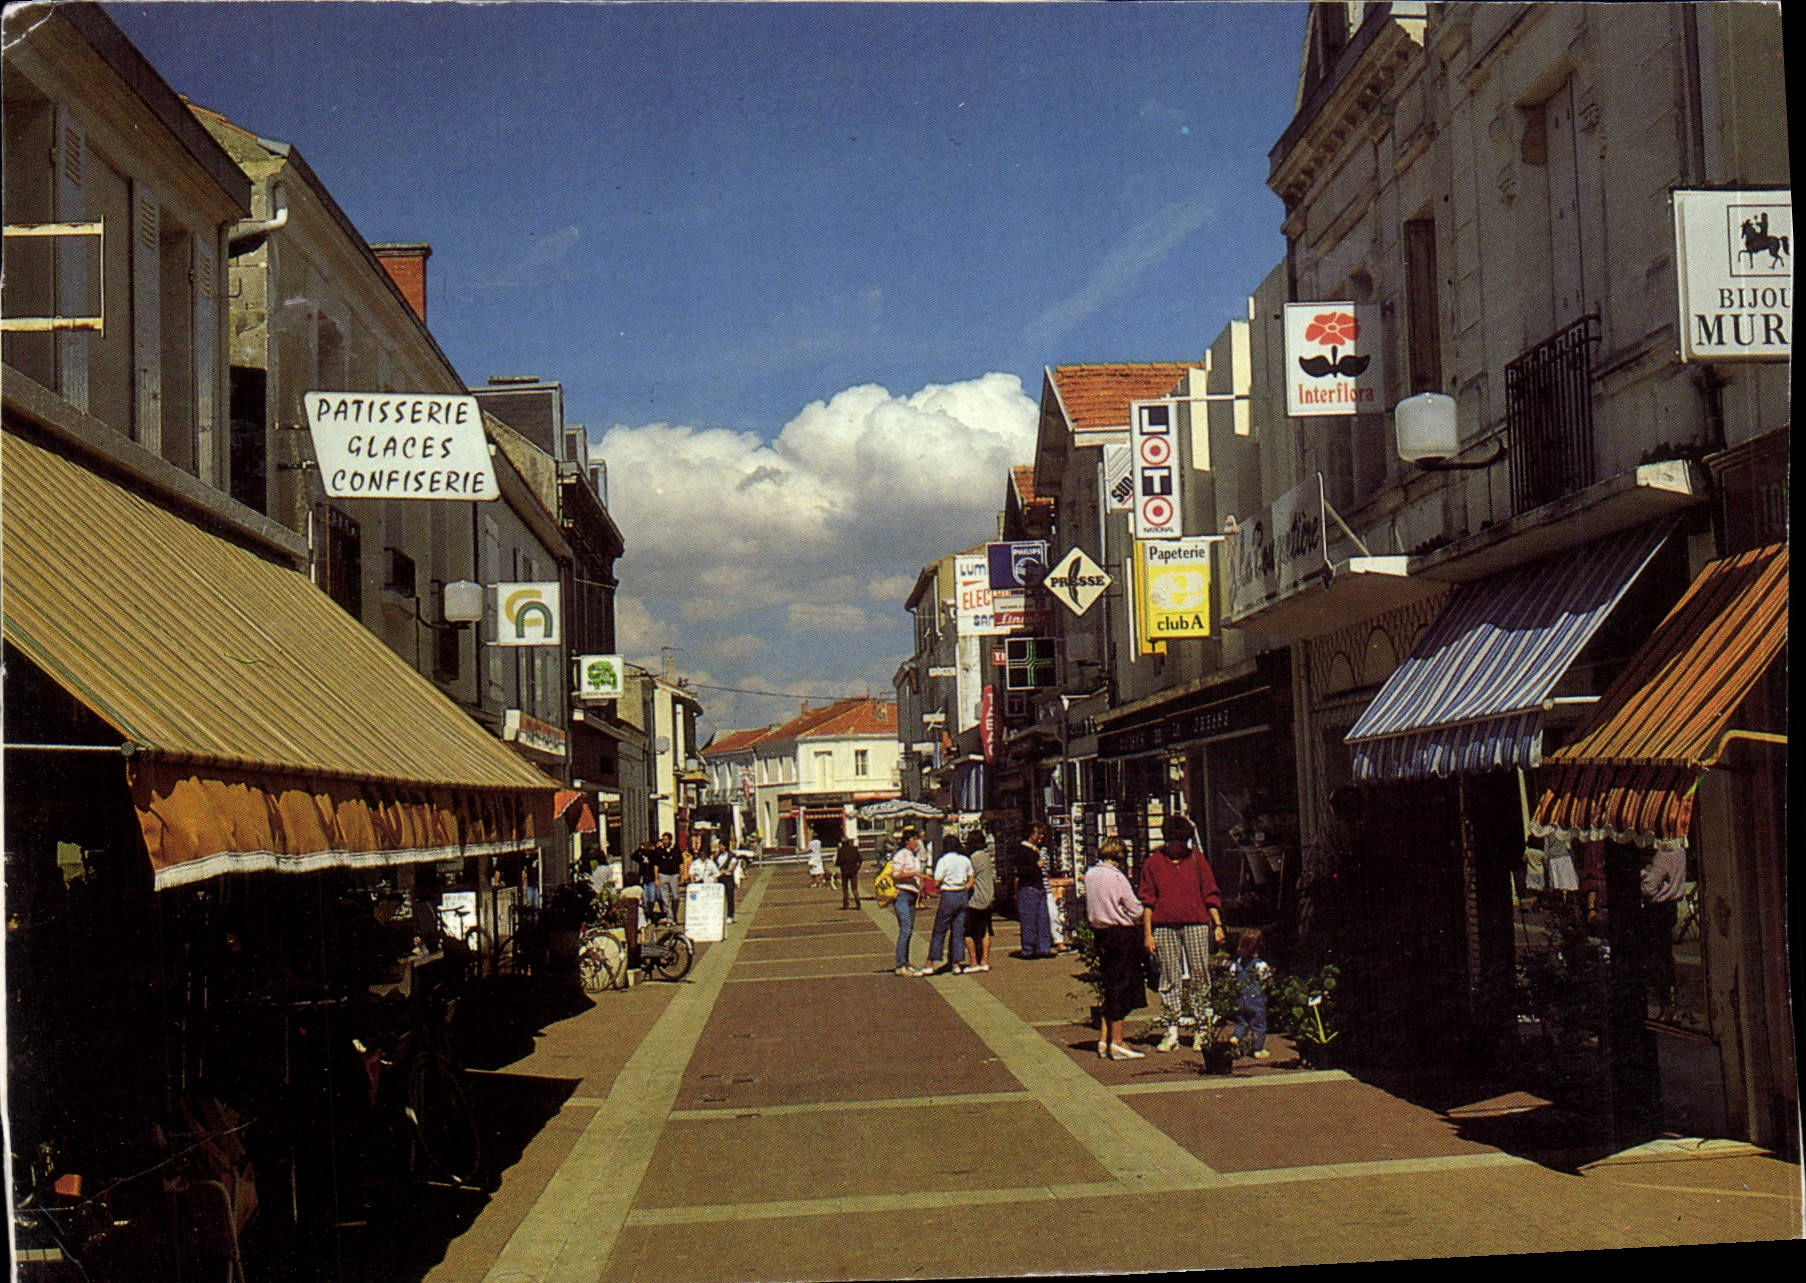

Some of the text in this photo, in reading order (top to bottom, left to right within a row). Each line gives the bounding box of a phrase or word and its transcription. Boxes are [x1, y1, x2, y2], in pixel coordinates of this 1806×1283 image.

[1694, 313, 1791, 346] MUR
[1297, 382, 1375, 405] Interflora
[317, 398, 469, 425] PATISSERIE
[347, 435, 454, 459] GLACES
[331, 468, 486, 494] CONFISERIE
[1149, 544, 1206, 564] Papeterie
